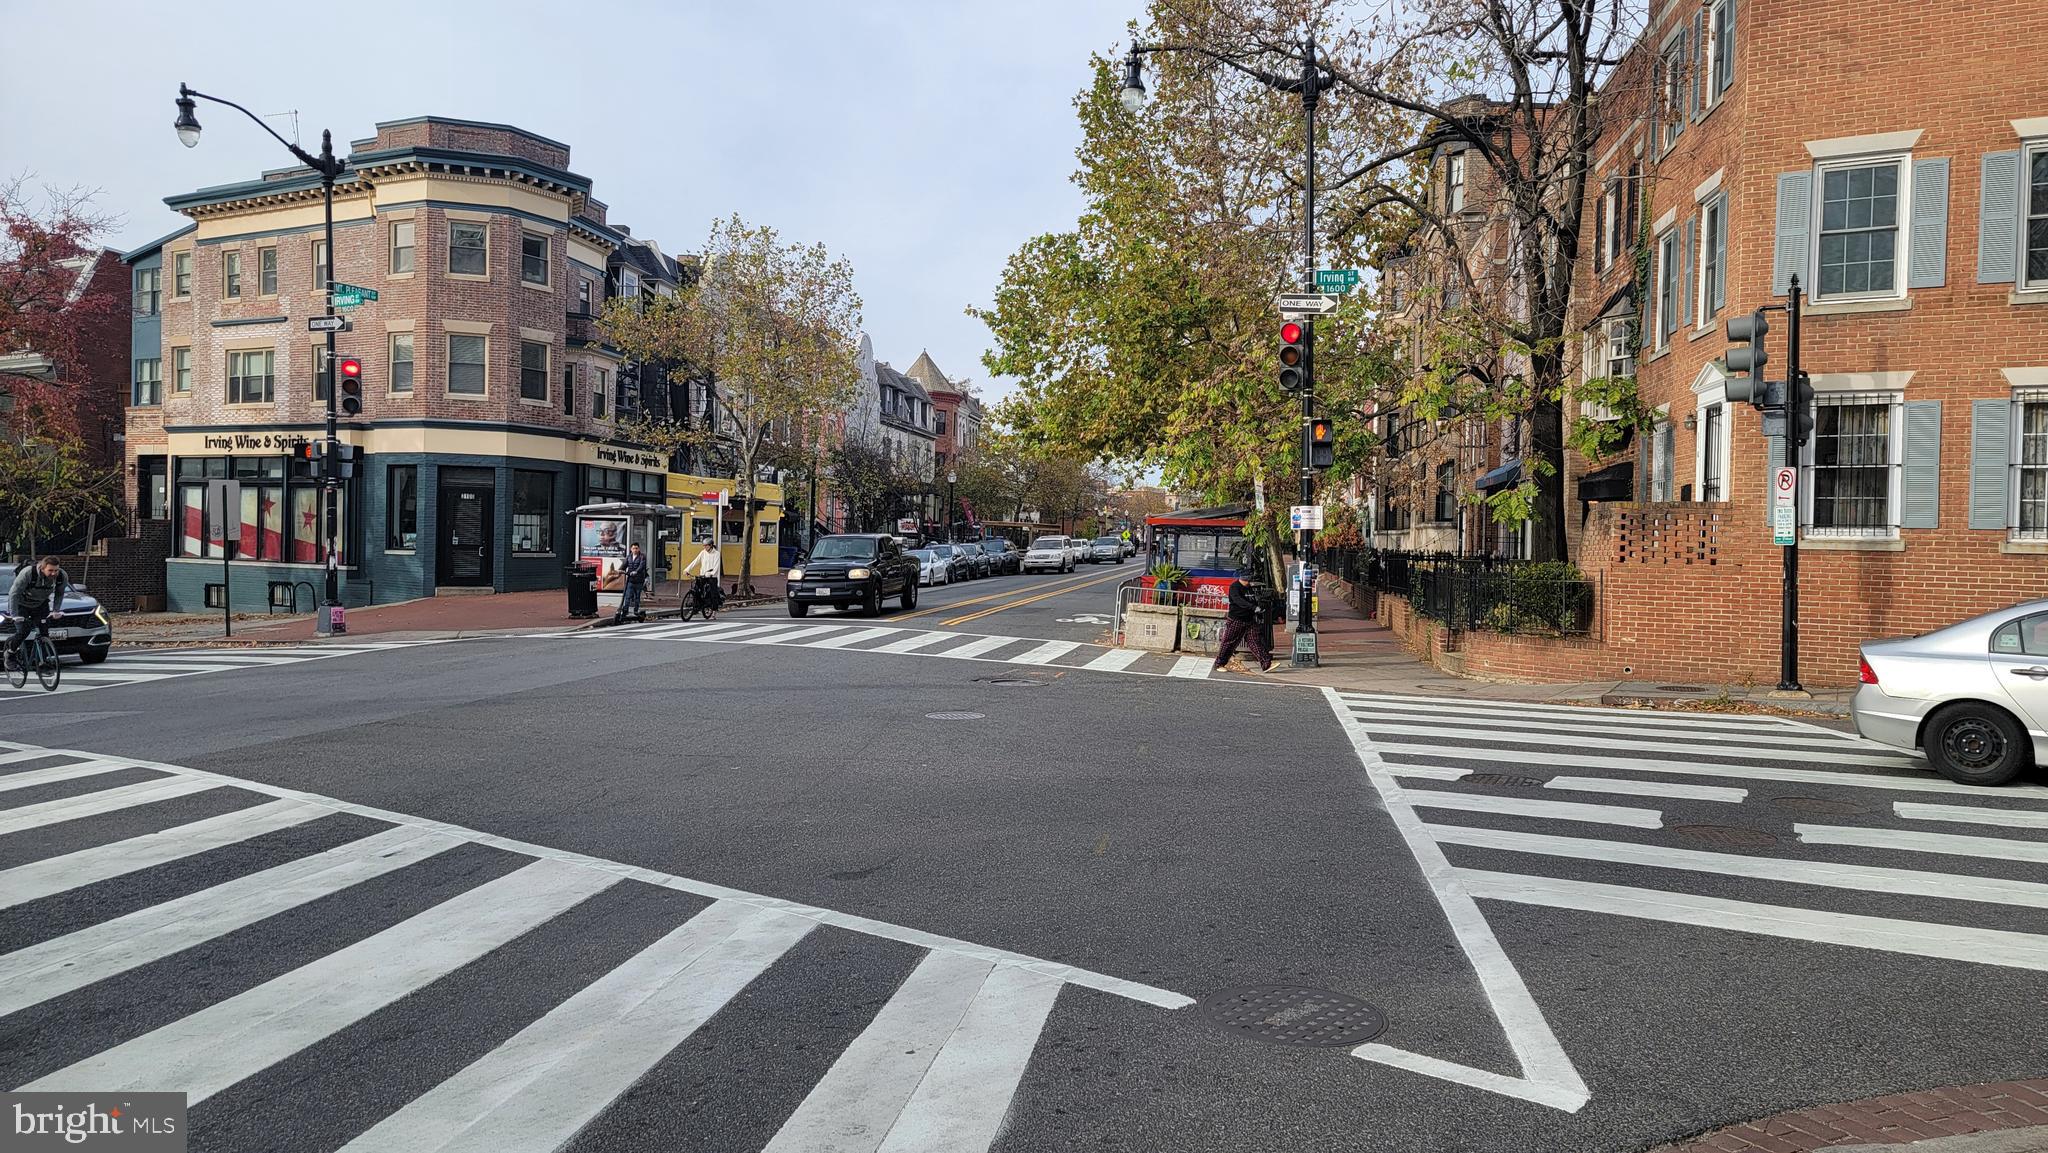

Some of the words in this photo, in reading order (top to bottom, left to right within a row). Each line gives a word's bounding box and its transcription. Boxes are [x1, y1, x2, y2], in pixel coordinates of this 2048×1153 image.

[1320, 271, 1344, 284] Irving
[1326, 284, 1346, 293] 1600
[335, 294, 355, 306] IRVING
[205, 435, 233, 452] Irving
[234, 434, 262, 449] Wine
[263, 435, 272, 448] &
[597, 447, 617, 464] Irving
[617, 449, 634, 464] Wine
[640, 452, 661, 469] Spirits
